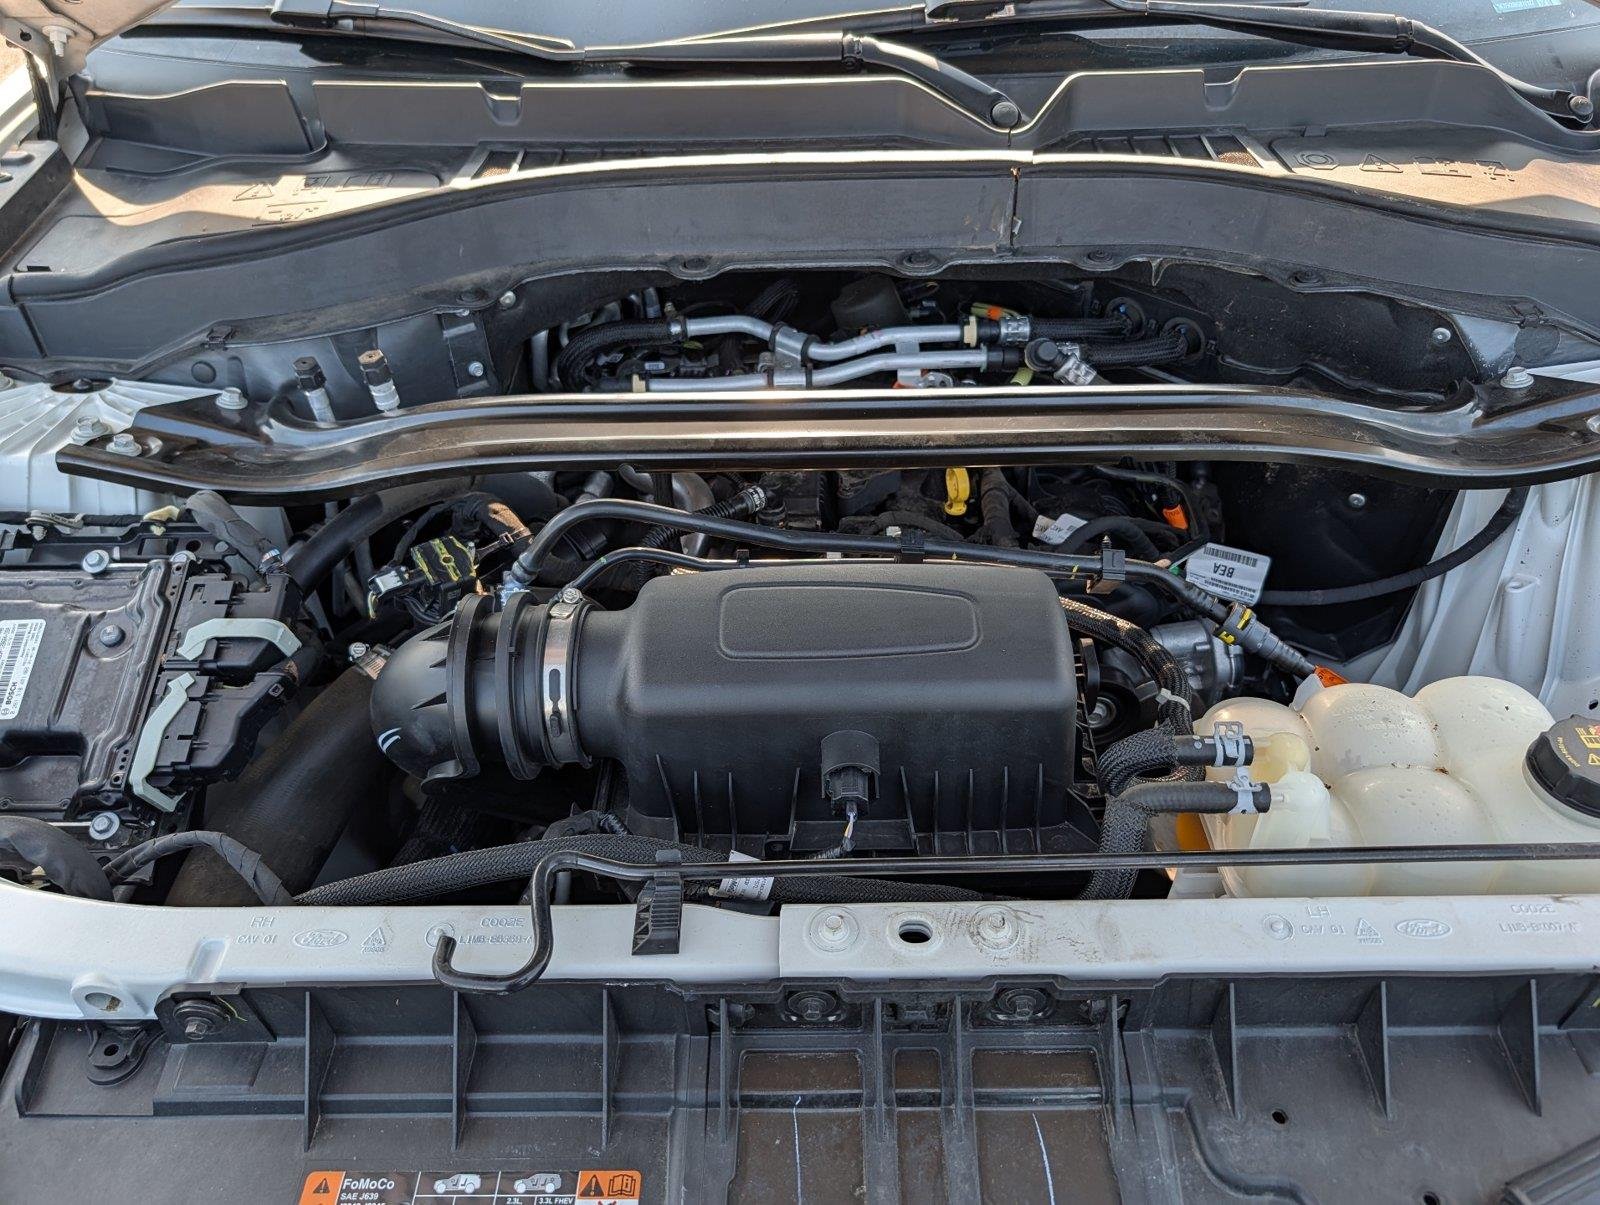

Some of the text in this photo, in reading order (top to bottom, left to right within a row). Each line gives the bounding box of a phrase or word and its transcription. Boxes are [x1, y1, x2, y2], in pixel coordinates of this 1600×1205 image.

[1213, 562, 1235, 578] BEA
[5, 681, 18, 705] BOSCH
[250, 915, 276, 929] RH
[1401, 919, 1447, 937] Ford
[299, 930, 344, 948] Ford
[342, 1178, 395, 1190] FoMoCo
[340, 1192, 379, 1200] SAE J639
[539, 1197, 574, 1205] 3.3L FHEV
